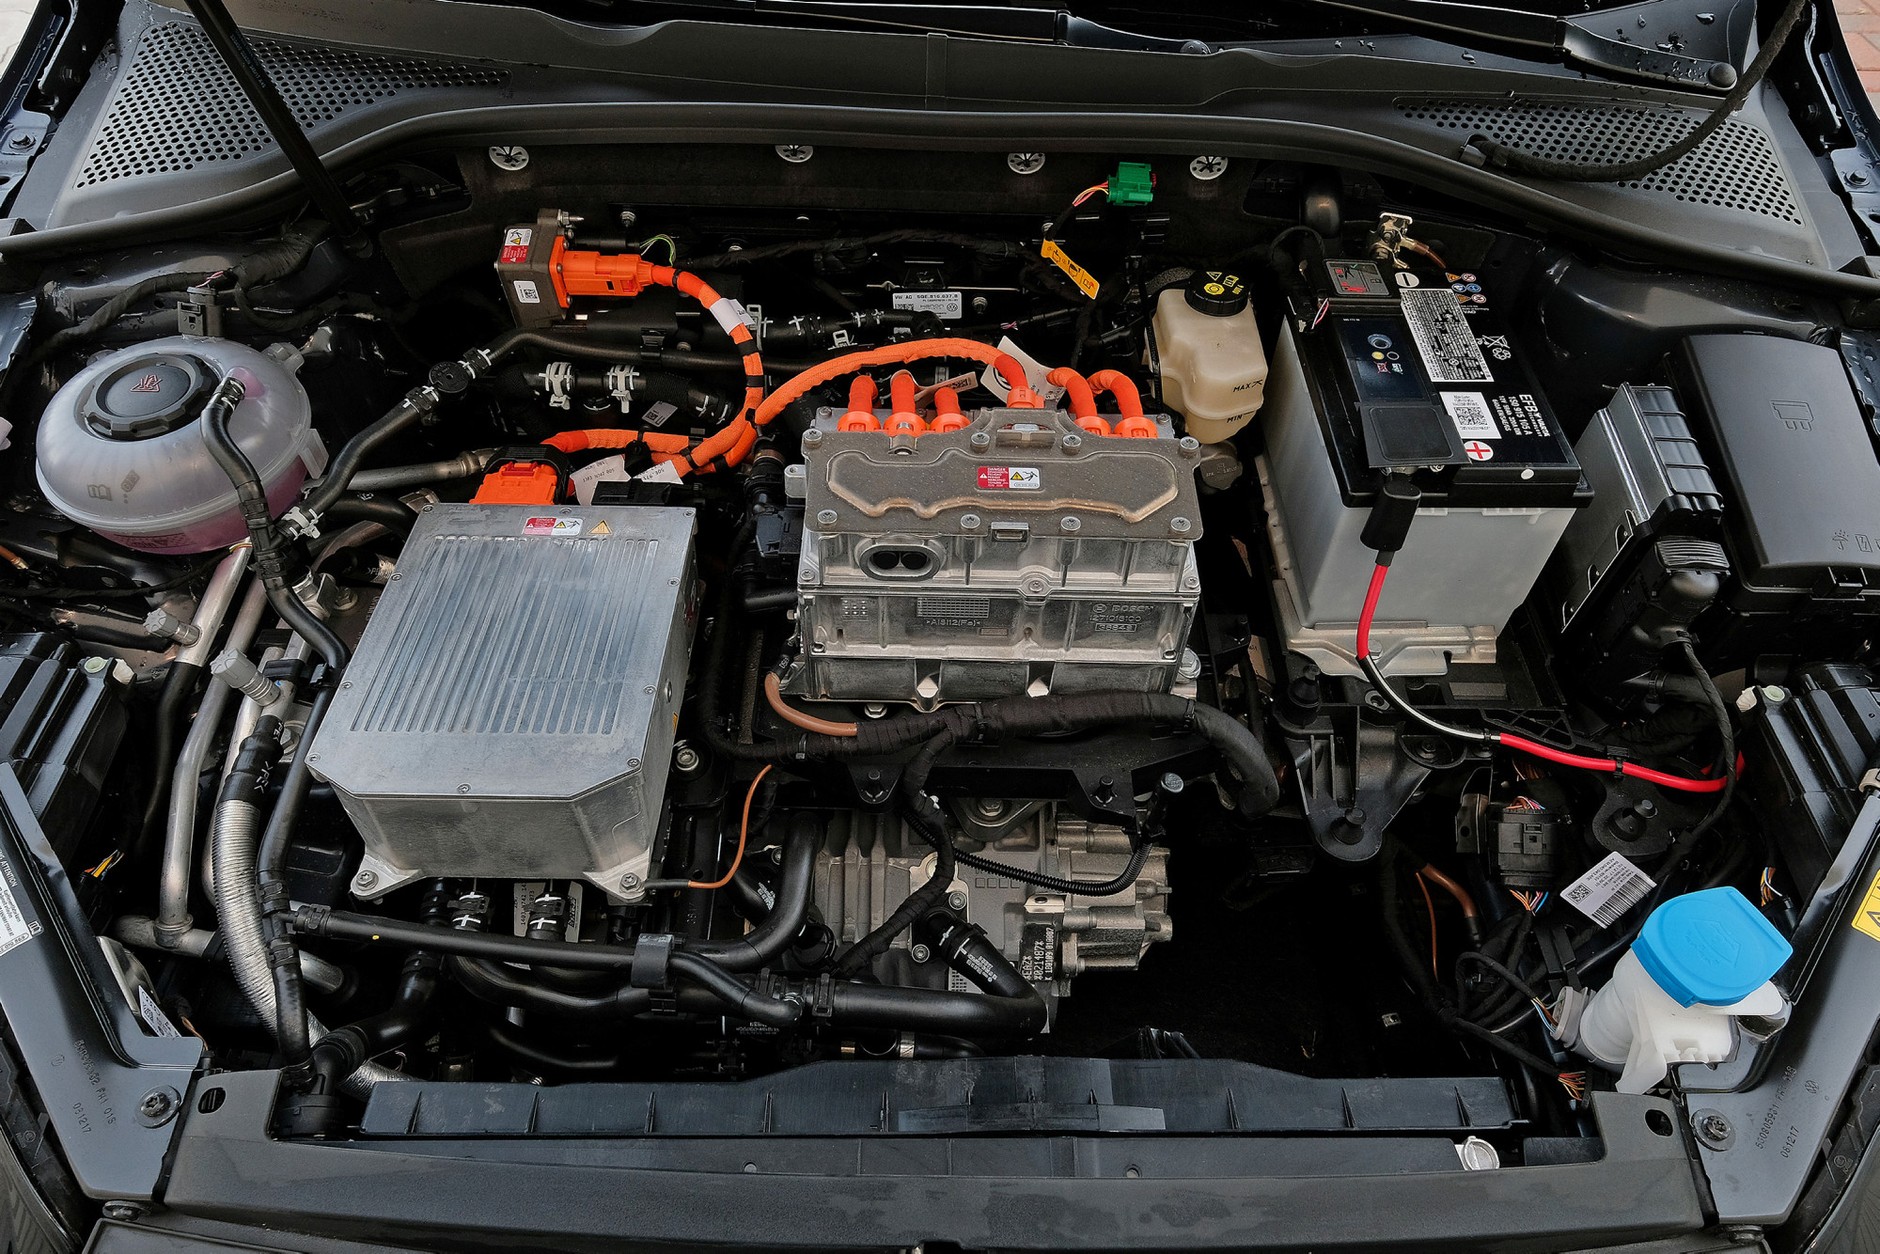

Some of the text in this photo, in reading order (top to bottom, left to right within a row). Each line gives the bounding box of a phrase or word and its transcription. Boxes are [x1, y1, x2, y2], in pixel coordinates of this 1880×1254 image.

[1232, 382, 1251, 392] MAX
[1518, 394, 1539, 413] EFB
[1226, 414, 1243, 423] MIN
